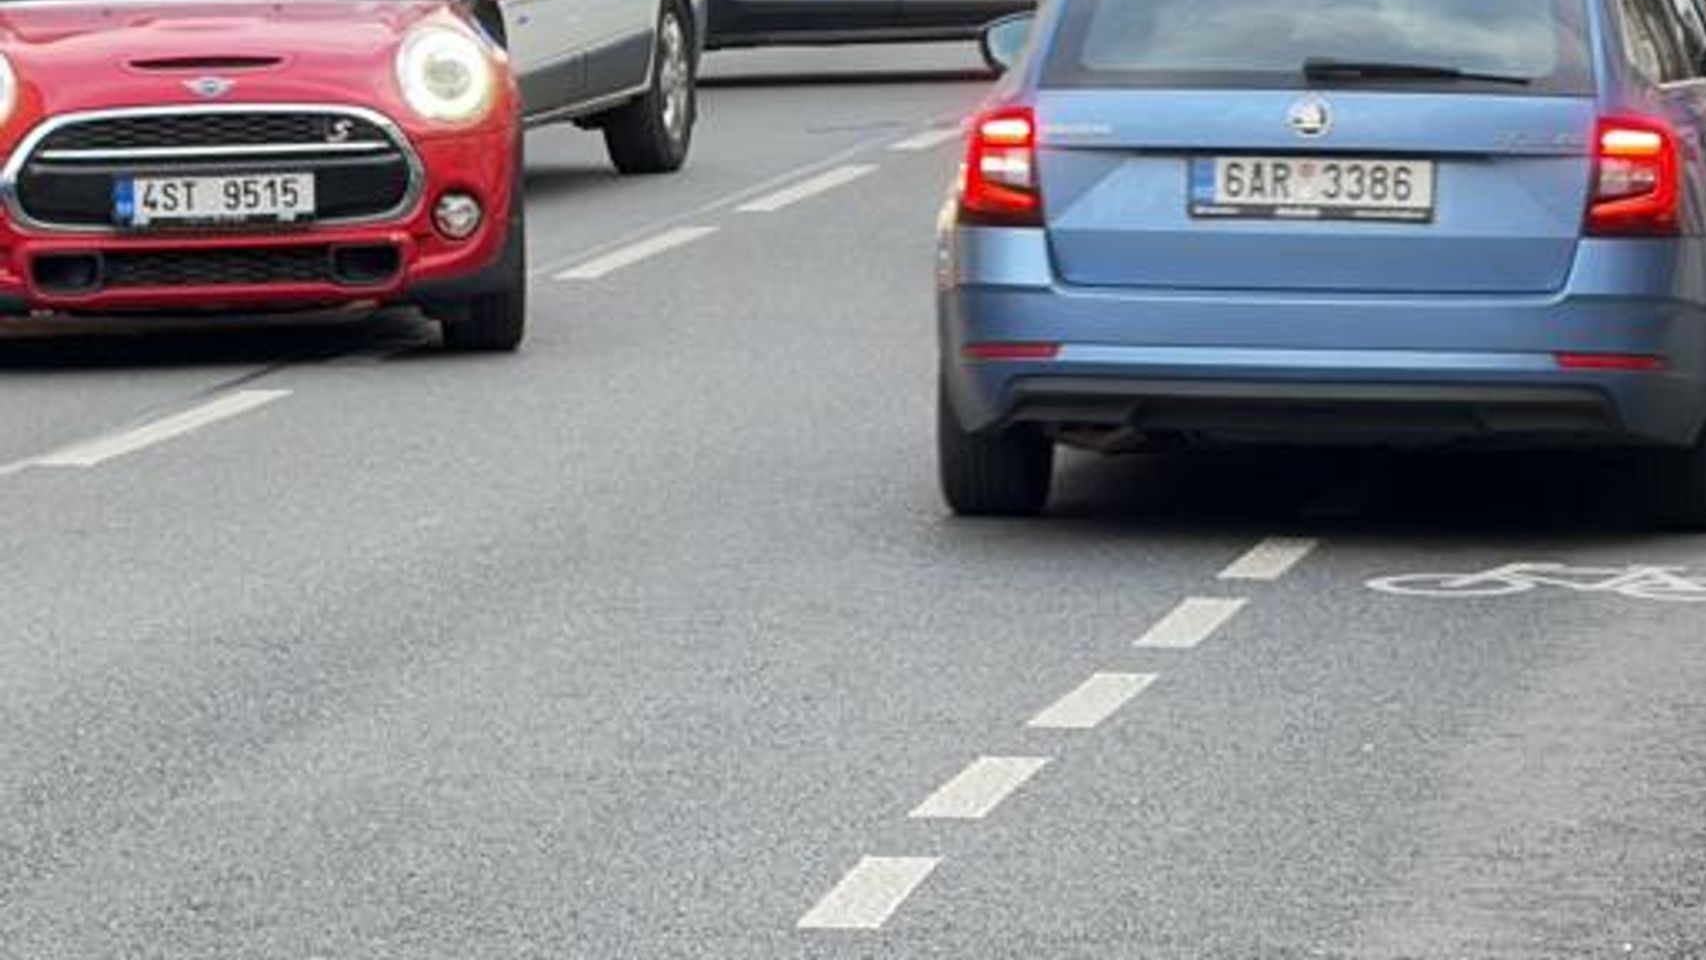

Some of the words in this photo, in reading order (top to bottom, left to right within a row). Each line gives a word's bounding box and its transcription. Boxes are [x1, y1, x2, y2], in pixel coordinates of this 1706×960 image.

[142, 182, 197, 211] 4ST
[223, 179, 298, 208] 9515
[1224, 162, 1291, 197] 6AR
[1322, 164, 1413, 200] 3386
